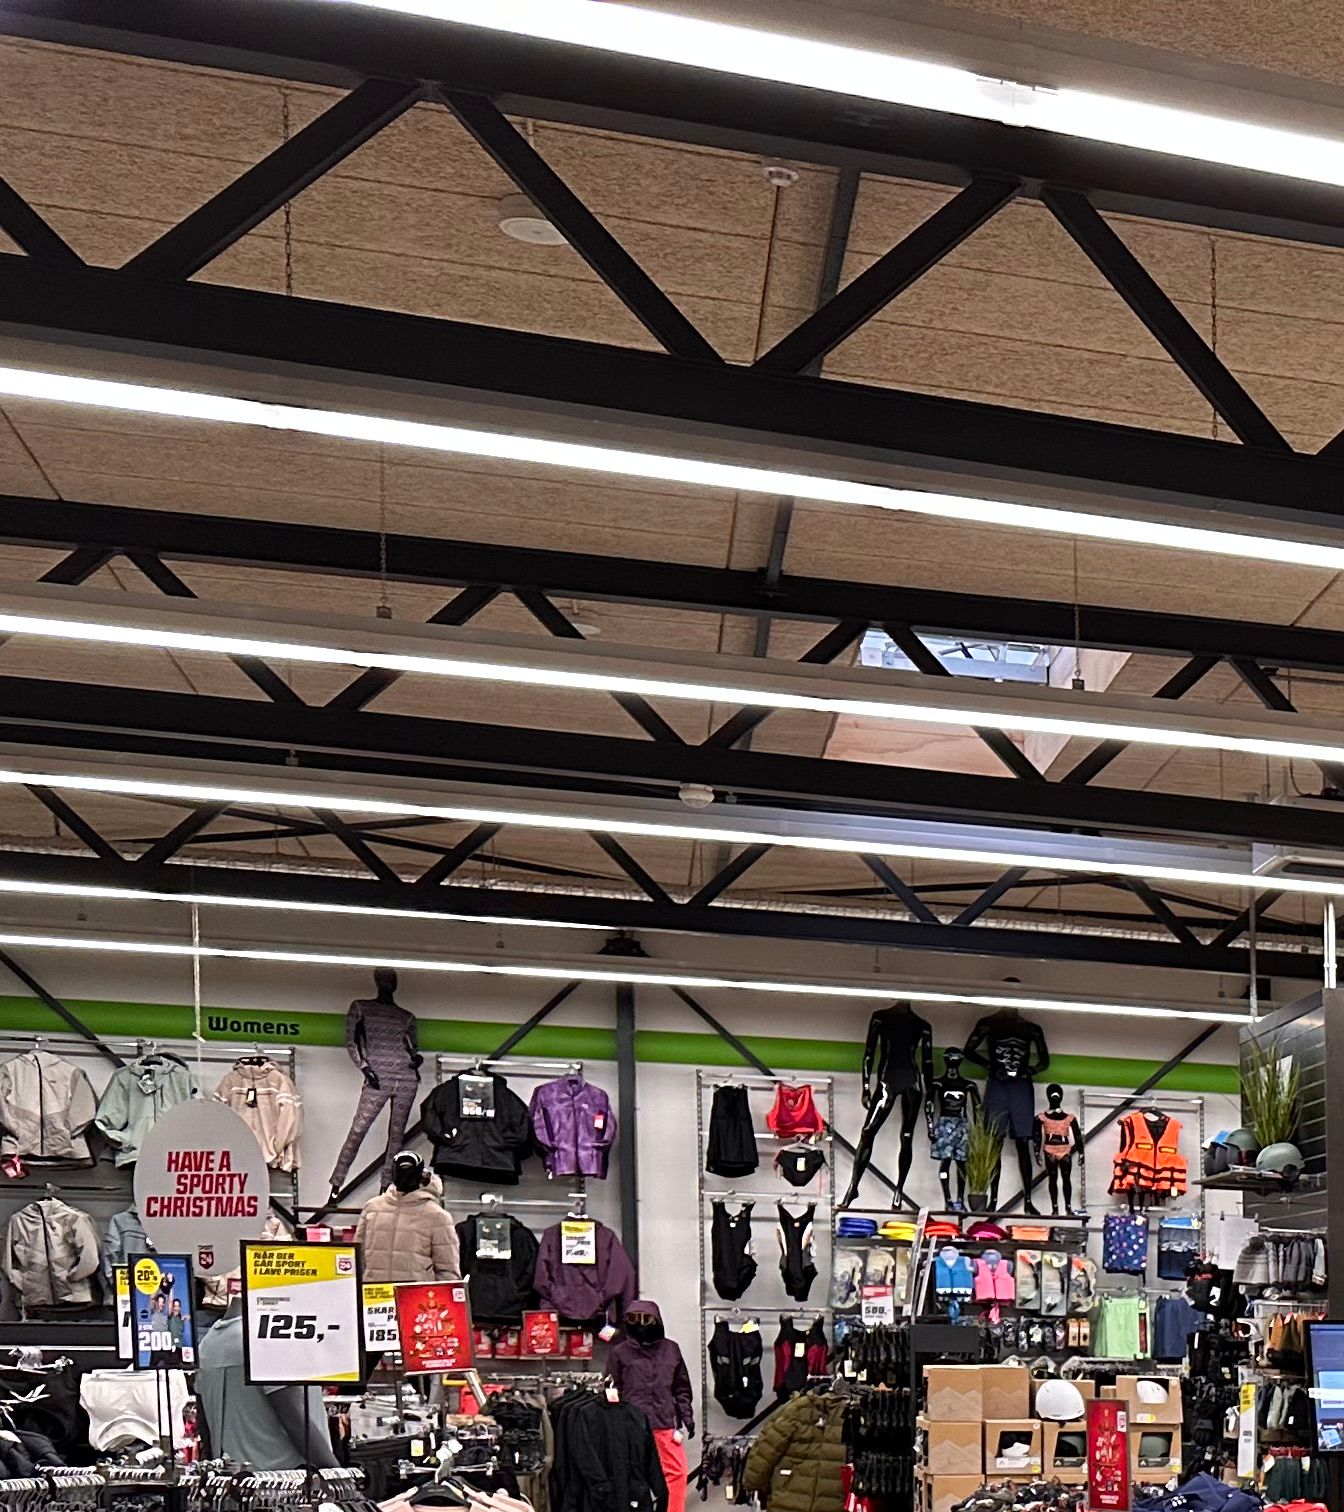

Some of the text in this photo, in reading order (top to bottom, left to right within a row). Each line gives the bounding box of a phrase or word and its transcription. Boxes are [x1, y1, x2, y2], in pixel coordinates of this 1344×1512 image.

[208, 1016, 300, 1036] Womens
[167, 1151, 231, 1172] HAVE A
[176, 1173, 248, 1195] SPORTY
[145, 1196, 258, 1217] CHRISTMAS
[367, 1306, 396, 1315] SKAR
[257, 1314, 340, 1343] 125,-
[369, 1328, 399, 1342] 185
